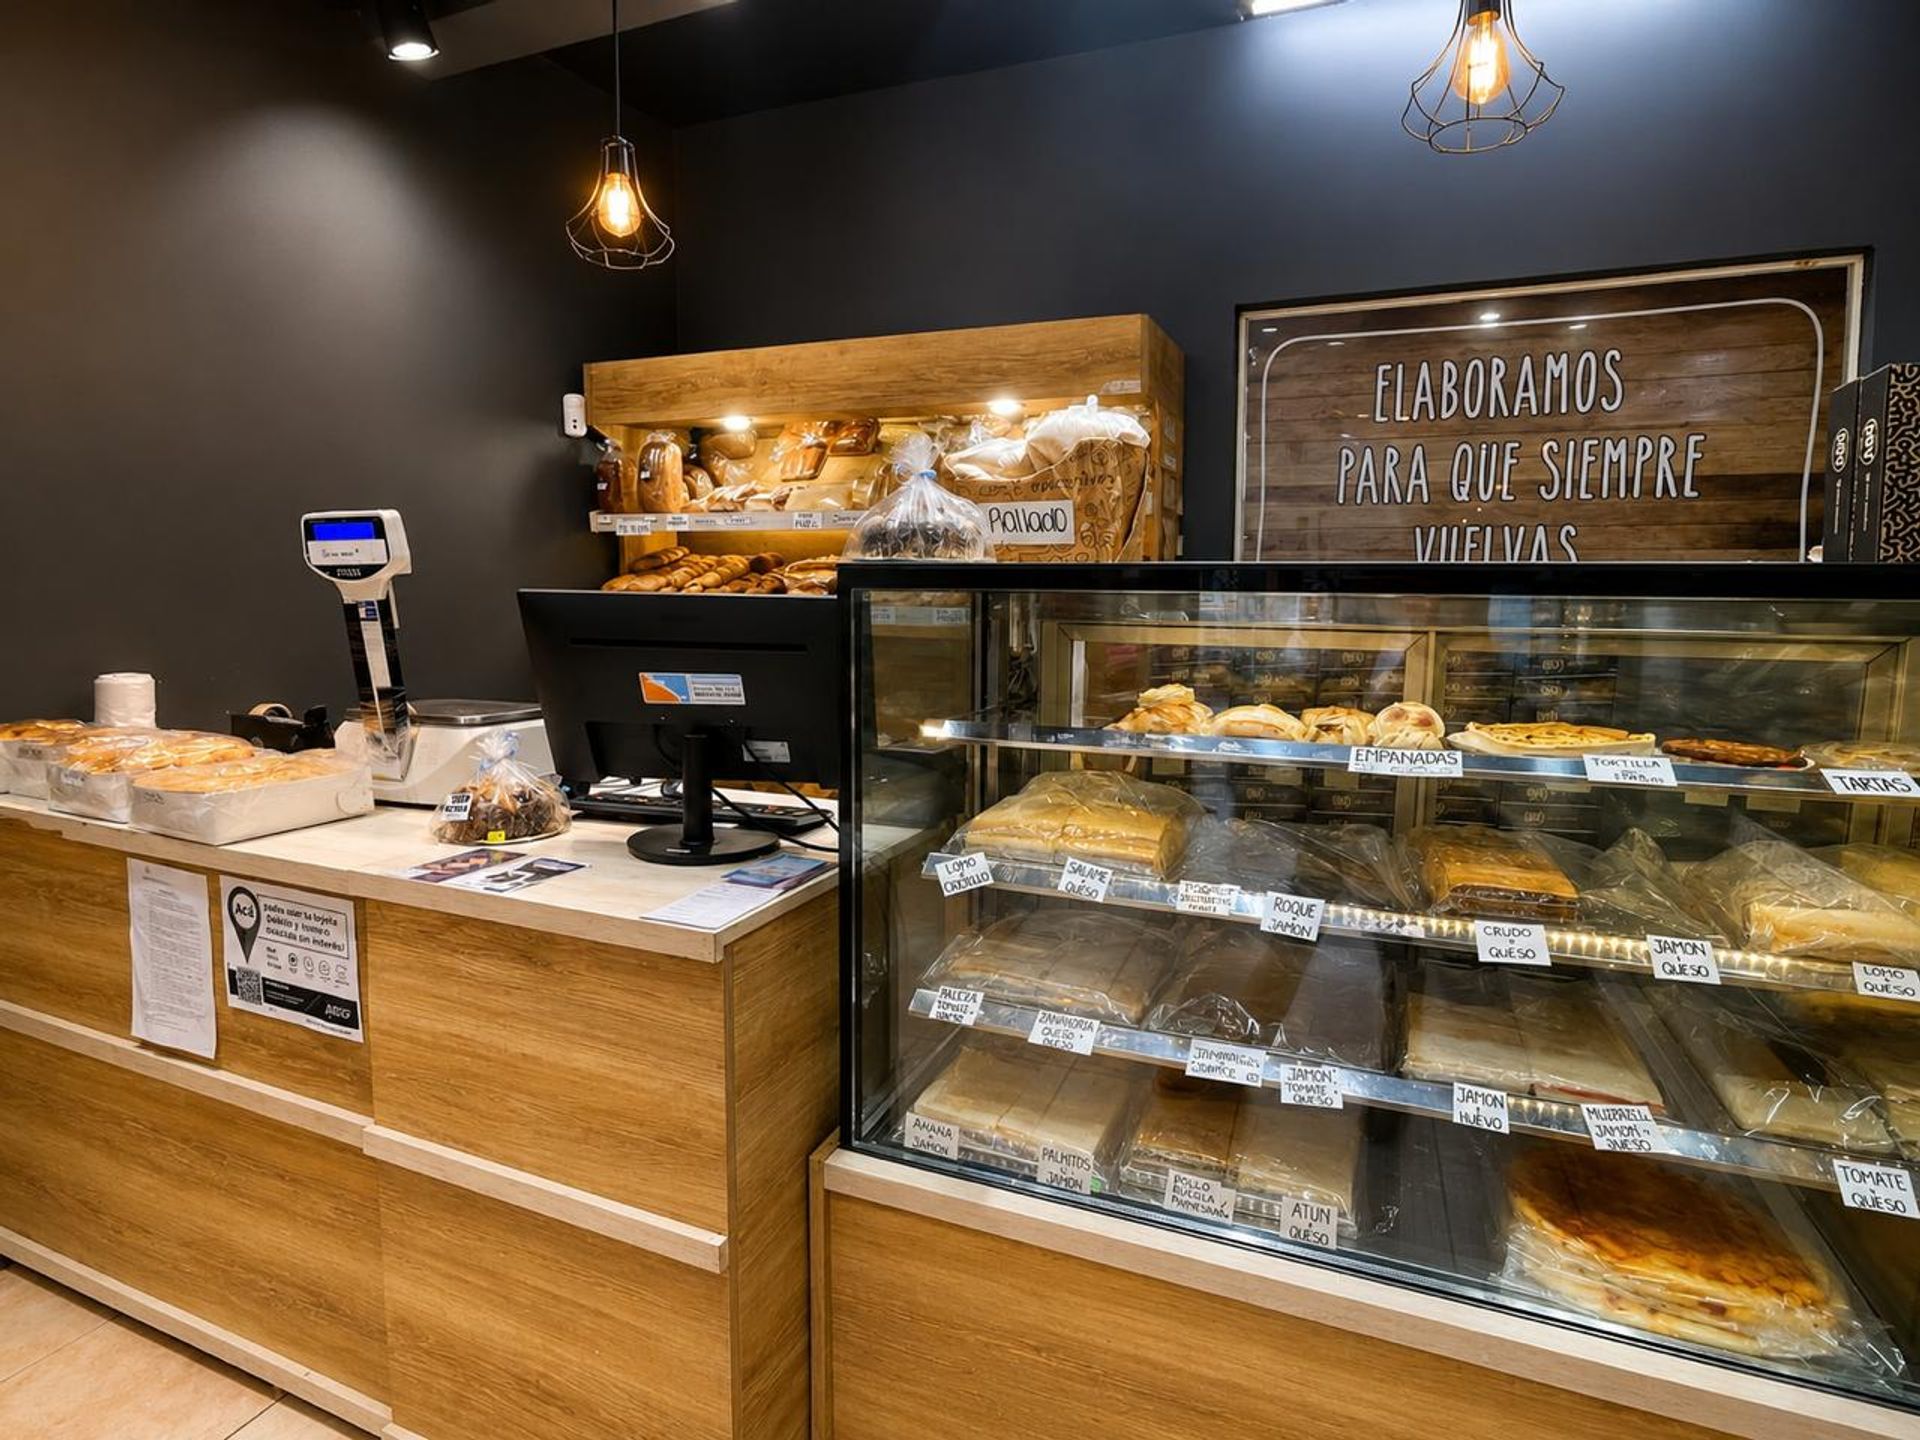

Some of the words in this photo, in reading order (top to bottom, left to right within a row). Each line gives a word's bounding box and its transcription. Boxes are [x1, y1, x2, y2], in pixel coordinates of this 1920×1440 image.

[1373, 348, 1624, 423] ELABORAMOS
[1336, 443, 1430, 505] PARA
[1450, 440, 1521, 503] QUE
[1537, 432, 1706, 501] SIEMPRE
[1354, 748, 1459, 766] EMPANADAS
[1591, 756, 1661, 768] TORTILLA
[1832, 775, 1912, 793] TARTAS
[945, 857, 977, 875] LOMO
[1069, 861, 1109, 884] SALAME
[1064, 880, 1099, 900] QUESO
[1273, 895, 1317, 919] ROQUE
[1267, 917, 1313, 938] JAMON
[1483, 925, 1532, 938] CRUDO
[1488, 946, 1536, 960] QUESO
[1653, 938, 1707, 957] JAMON
[1662, 961, 1710, 978] QUESO
[1863, 965, 1905, 980] LOMO
[1864, 980, 1916, 997] QUESO
[1286, 1067, 1333, 1084] JAMON
[1284, 1081, 1328, 1096] TOMATE
[1456, 1086, 1505, 1109] JAMON
[1459, 1111, 1503, 1129] HUEVO
[1174, 1174, 1211, 1192] POLLO
[1838, 1164, 1907, 1192] TOMATE
[1851, 1192, 1907, 1214] QUESO
[1291, 1202, 1331, 1225] ATUN
[1288, 1225, 1329, 1246] QUESO
